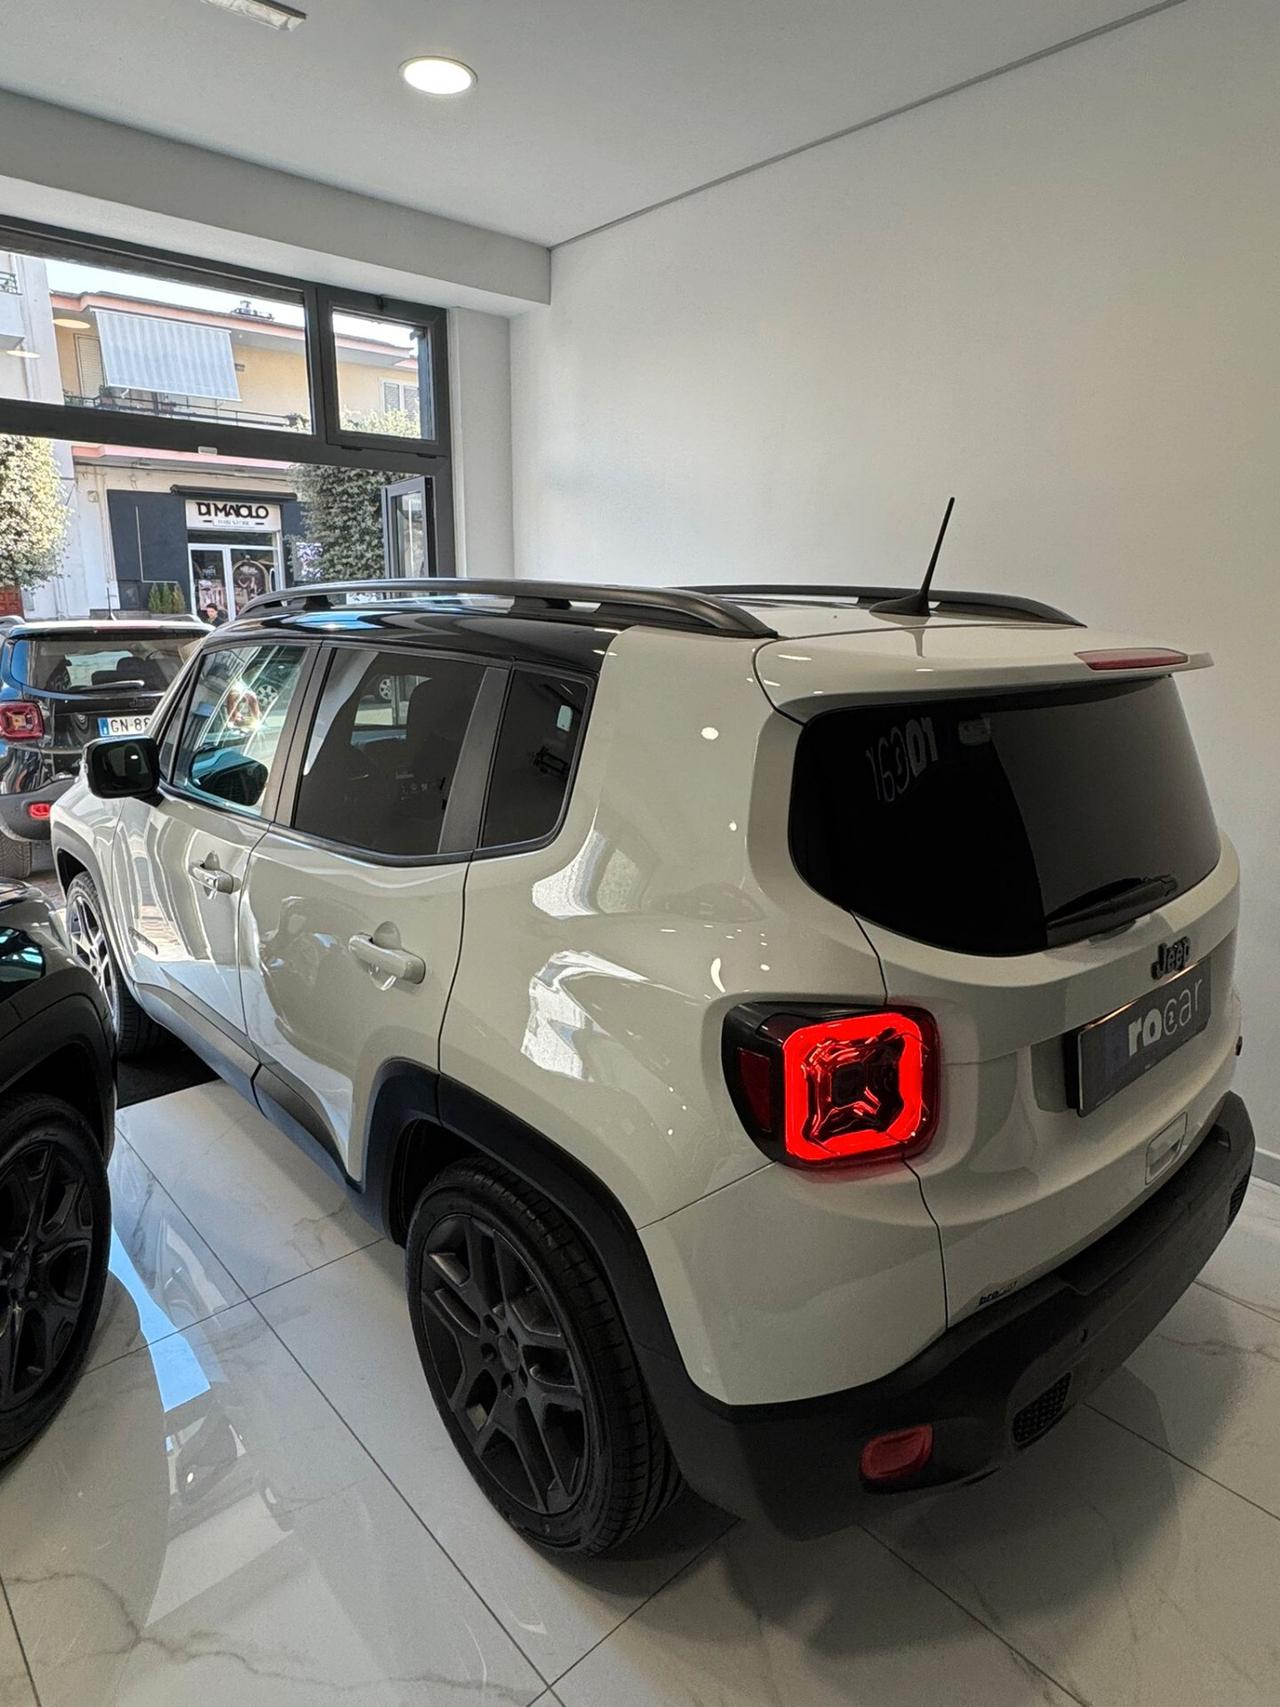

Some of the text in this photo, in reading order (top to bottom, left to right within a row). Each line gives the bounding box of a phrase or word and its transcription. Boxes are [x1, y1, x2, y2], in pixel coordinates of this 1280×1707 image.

[196, 502, 269, 519] DI MAIOLO
[1151, 936, 1192, 979] Jeep
